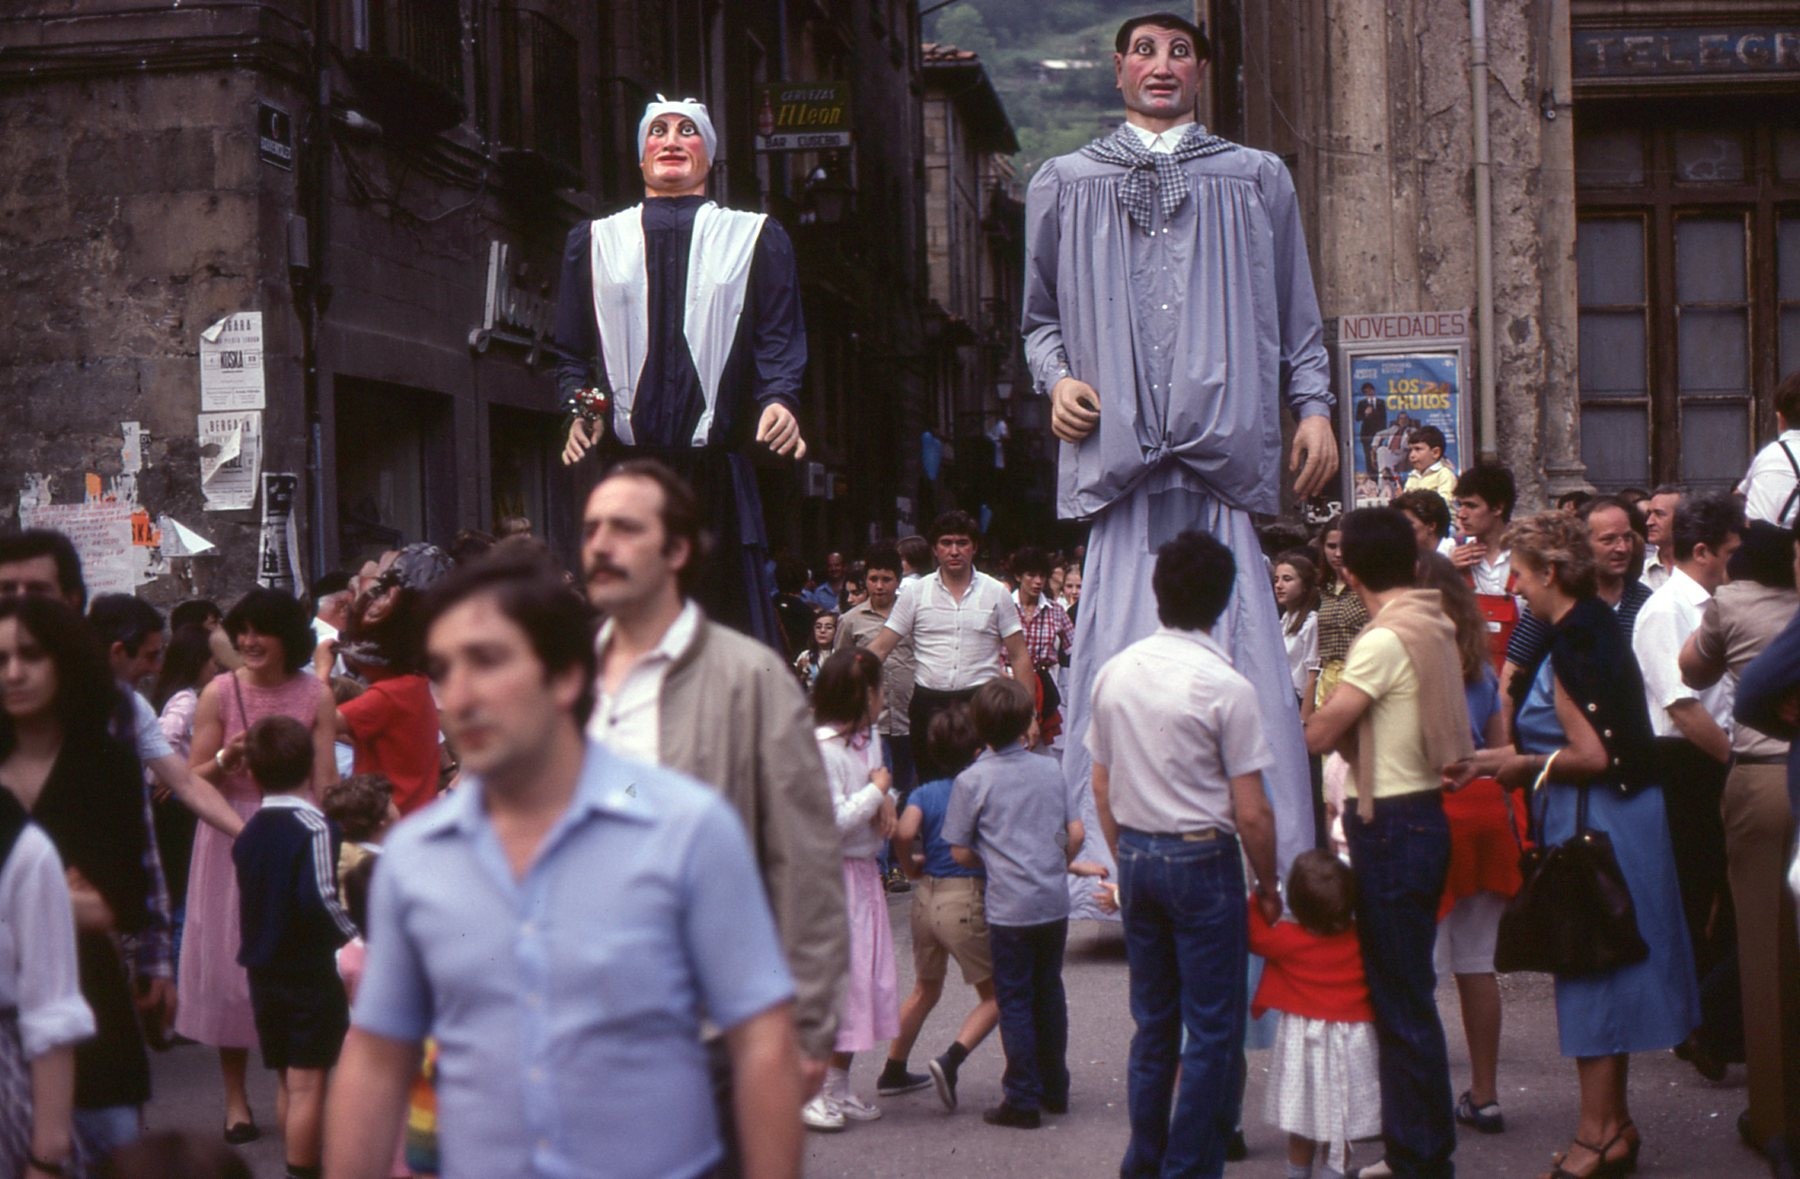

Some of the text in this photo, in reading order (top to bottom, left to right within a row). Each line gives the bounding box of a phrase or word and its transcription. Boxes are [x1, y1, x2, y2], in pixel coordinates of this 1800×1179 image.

[1344, 313, 1465, 339] NOVEDADES
[220, 350, 244, 369] KOSKA
[1387, 378, 1420, 394] LOS
[1385, 393, 1451, 411] CHULOS
